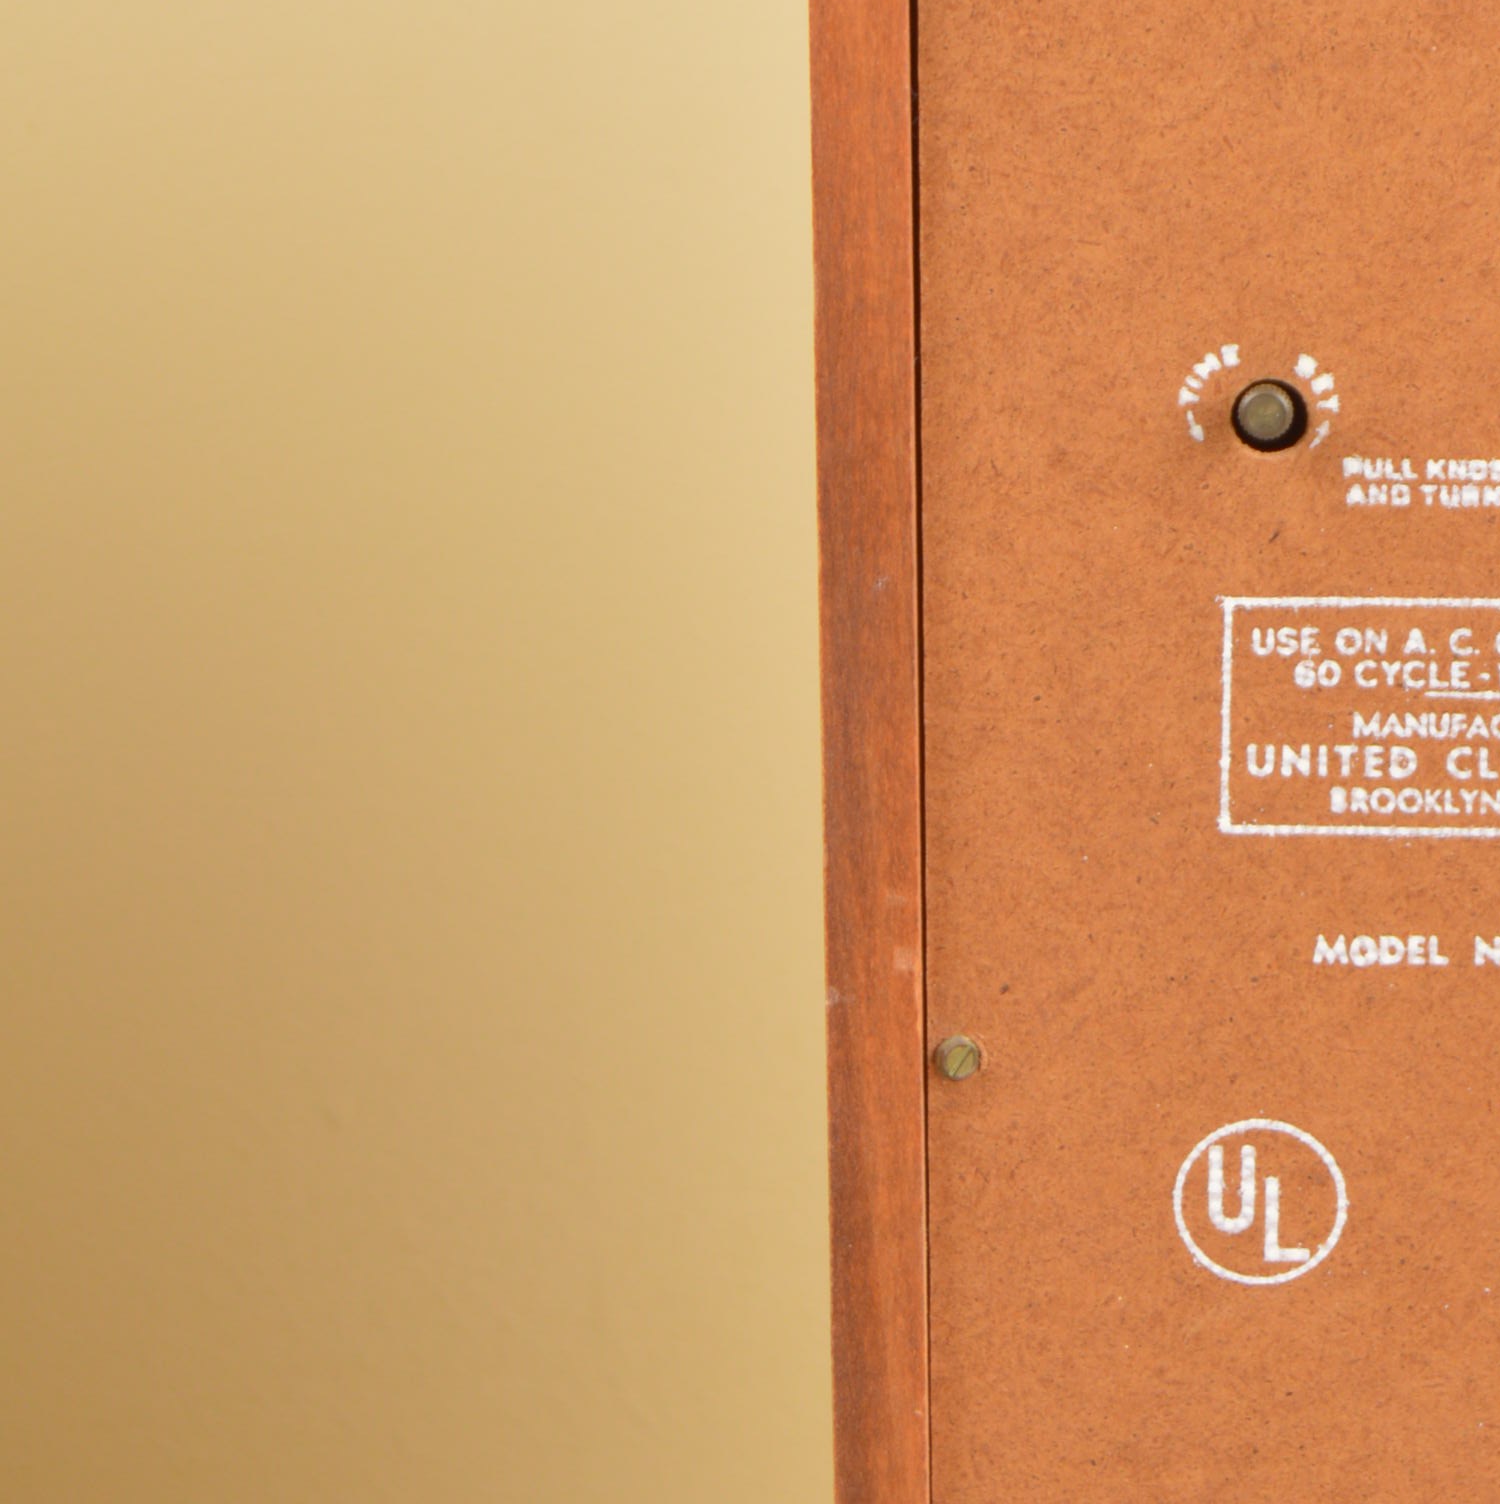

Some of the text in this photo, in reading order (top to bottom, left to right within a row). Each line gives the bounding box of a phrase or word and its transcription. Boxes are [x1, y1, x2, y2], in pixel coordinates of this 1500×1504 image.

[1342, 455, 1418, 481] PULL
[1346, 483, 1411, 507] AND
[1251, 626, 1321, 657] USE
[1335, 627, 1389, 655] ON
[1294, 659, 1342, 689] 60
[1246, 743, 1418, 781] UNITED
[1312, 933, 1450, 968] MODEL
[1207, 1144, 1312, 1264] UL
